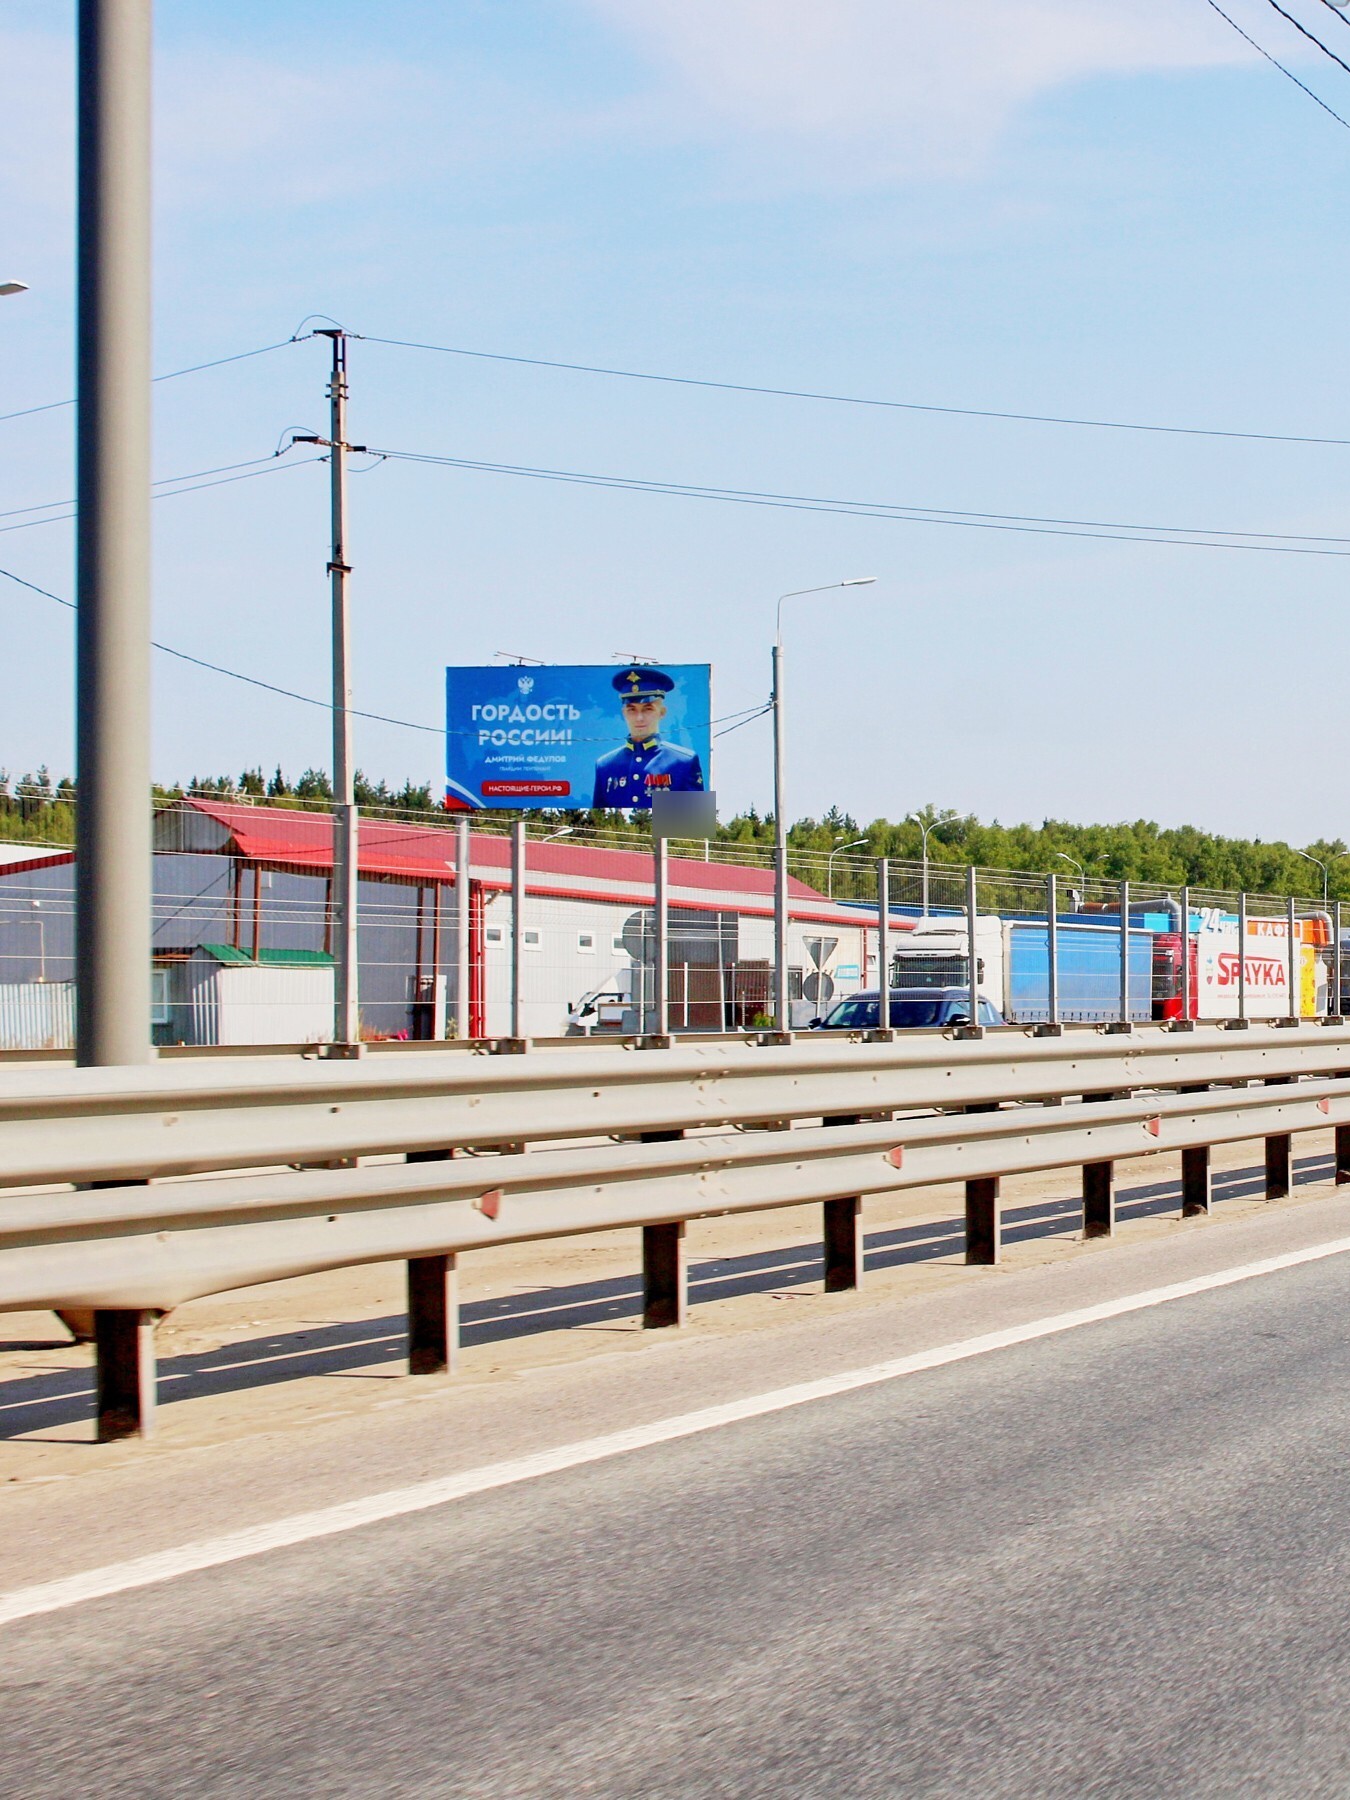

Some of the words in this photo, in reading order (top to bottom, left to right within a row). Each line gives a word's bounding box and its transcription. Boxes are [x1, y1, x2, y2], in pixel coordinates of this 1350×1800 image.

[471, 704, 581, 724] ГОРДОСТЬ
[478, 728, 573, 746] РОССИИ!
[484, 754, 525, 764] ДМИТРИЙ
[488, 785, 563, 793] НАСТОЯЩИЕ-ГЕРОИ.РФ
[1200, 907, 1222, 933] 24
[1217, 952, 1286, 986] SPAYKA
